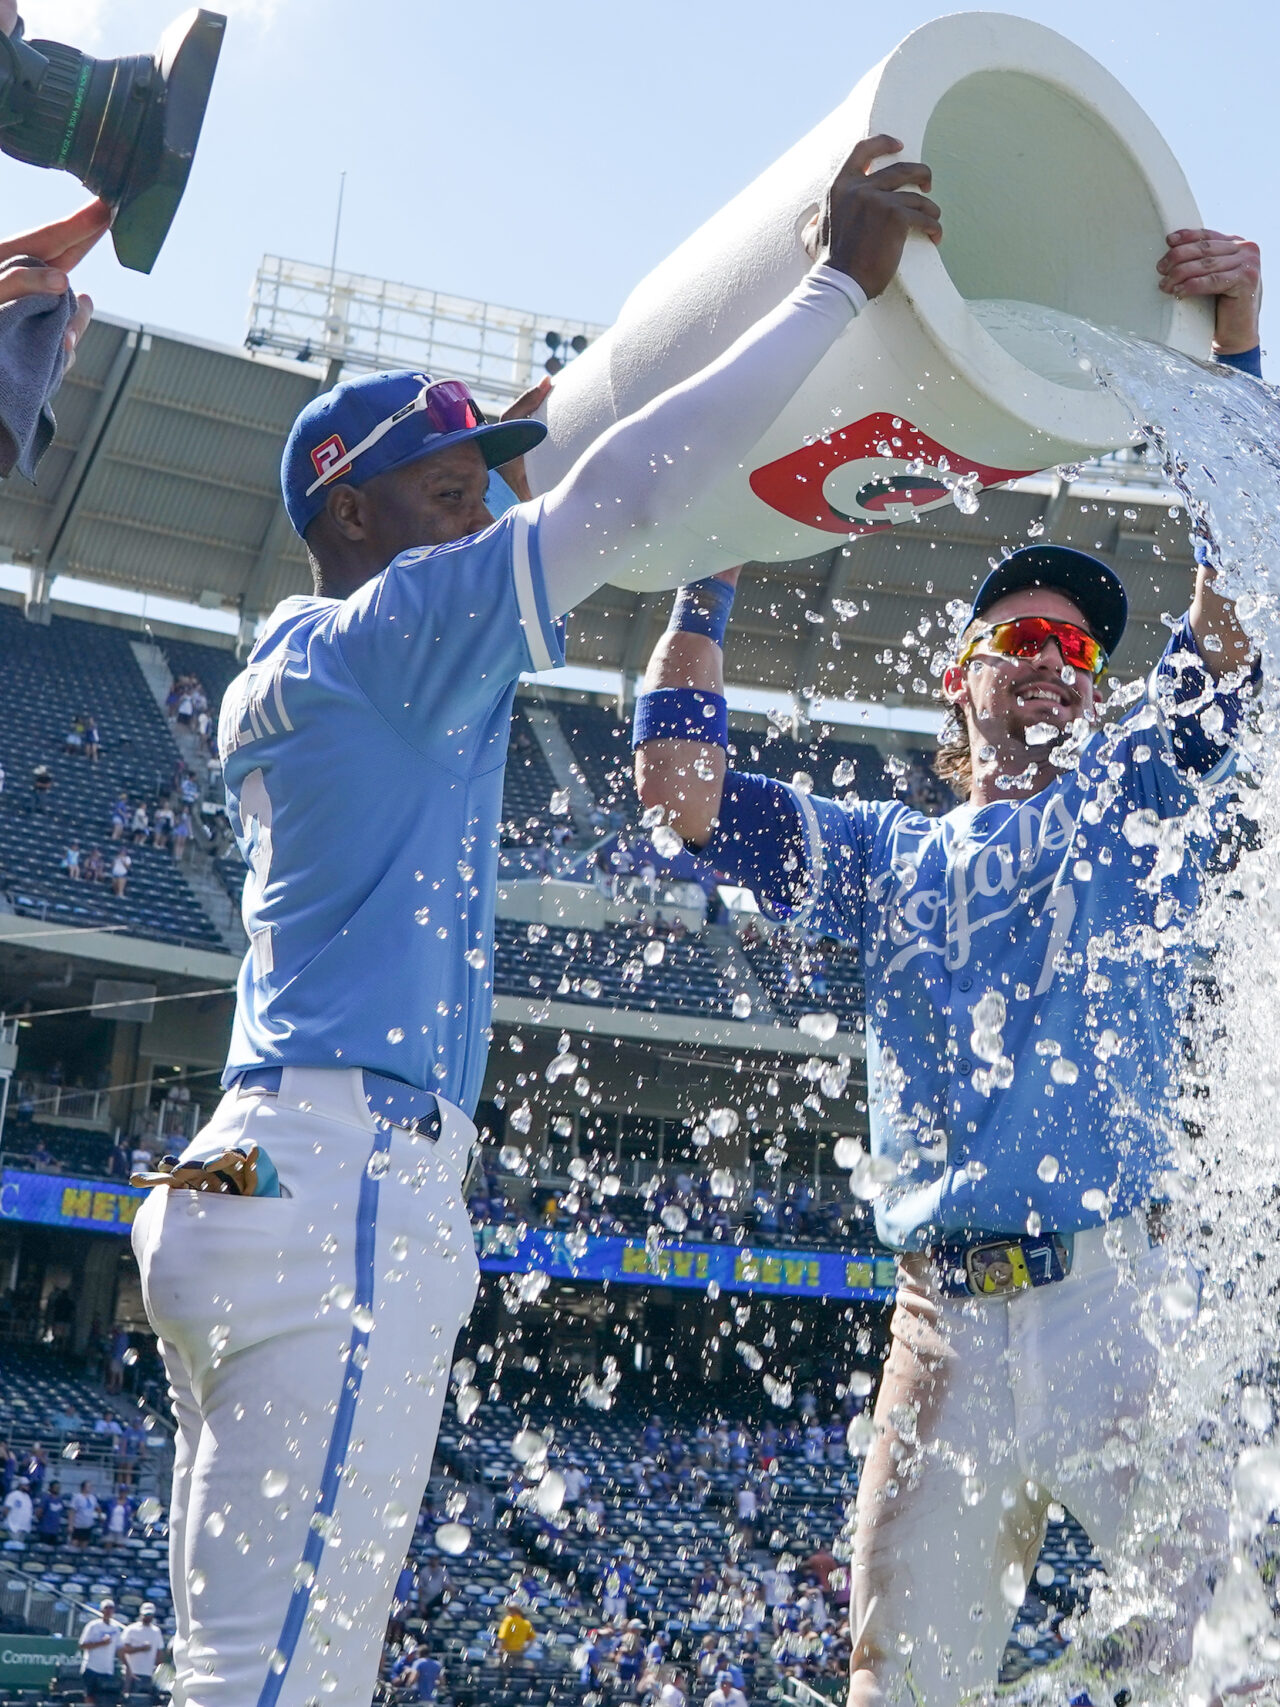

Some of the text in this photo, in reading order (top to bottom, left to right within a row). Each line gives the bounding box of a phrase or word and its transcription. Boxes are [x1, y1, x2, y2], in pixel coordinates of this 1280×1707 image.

[316, 442, 339, 473] 2
[864, 793, 1076, 972] Royals
[622, 1248, 709, 1279] HEY!
[1029, 1246, 1052, 1279] 7
